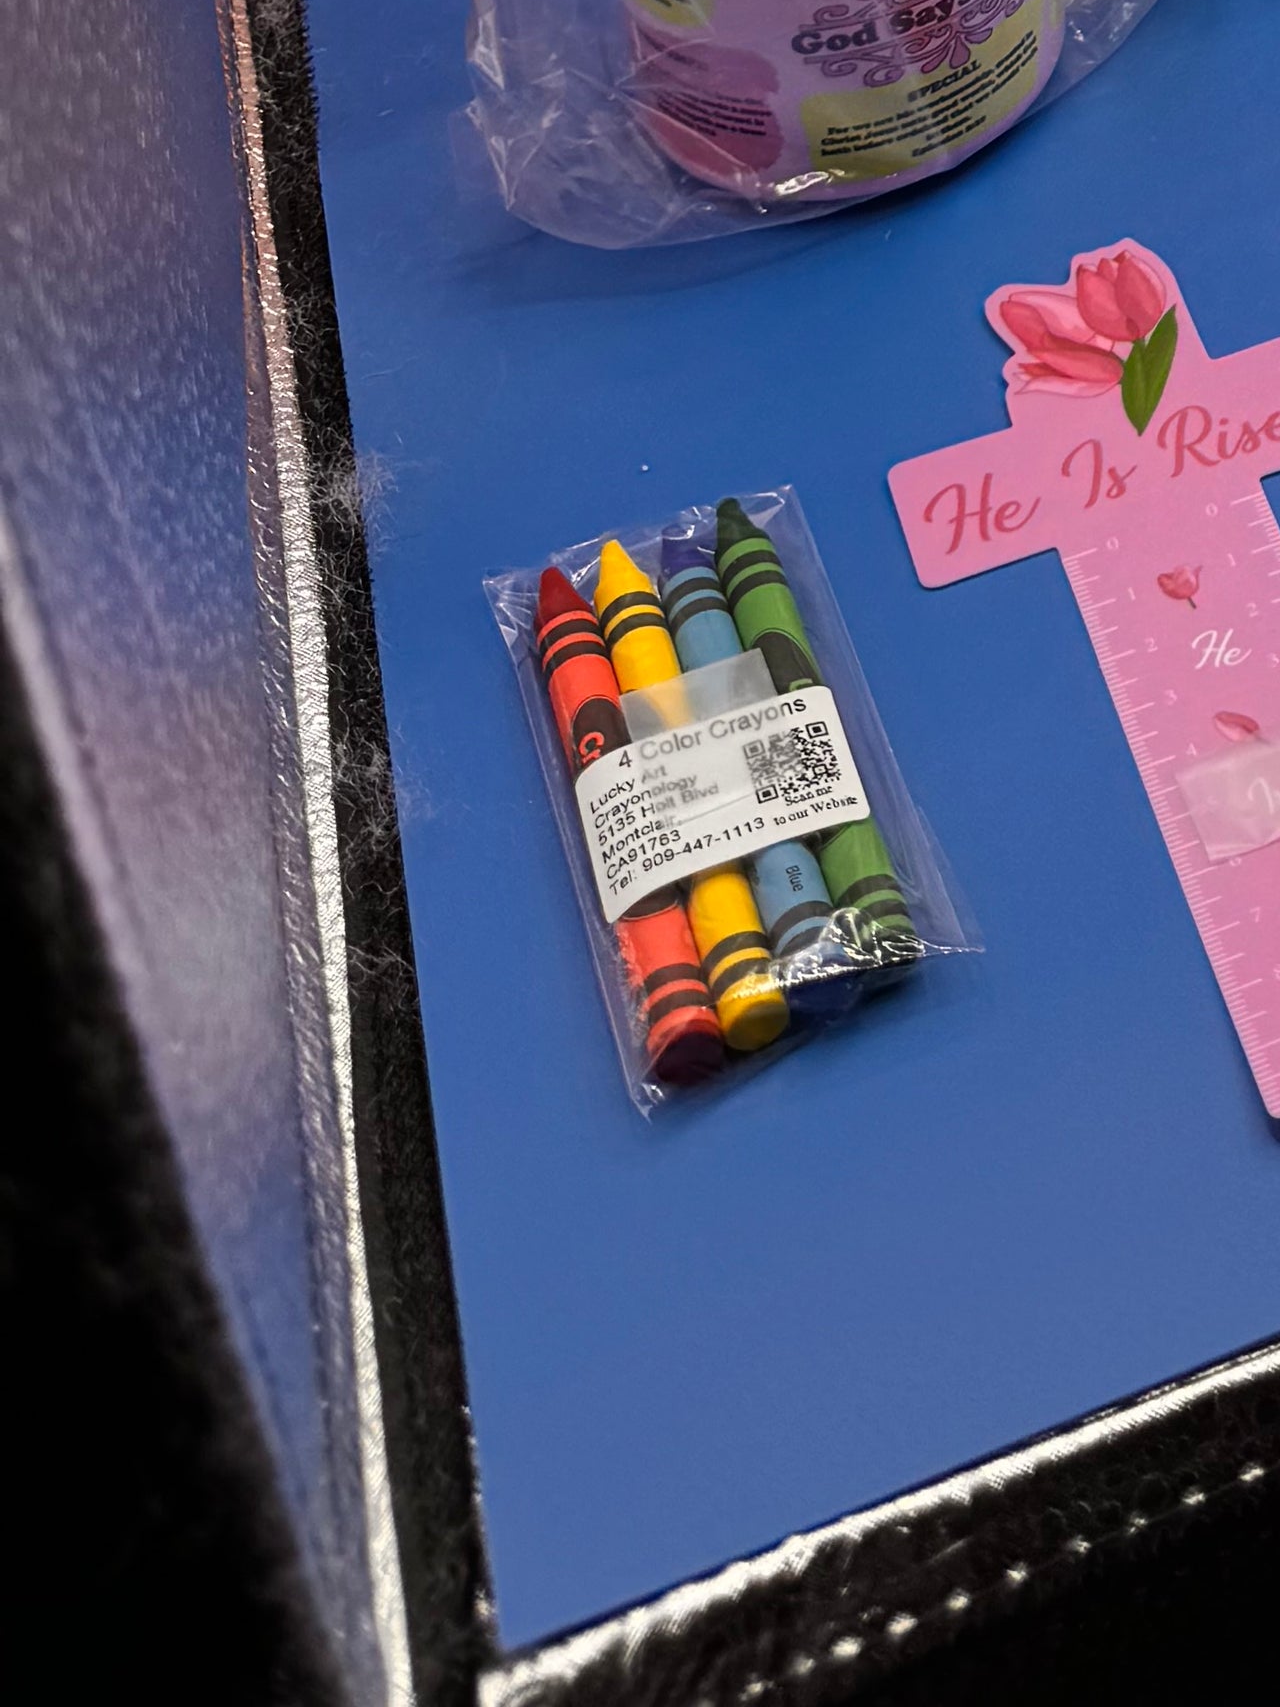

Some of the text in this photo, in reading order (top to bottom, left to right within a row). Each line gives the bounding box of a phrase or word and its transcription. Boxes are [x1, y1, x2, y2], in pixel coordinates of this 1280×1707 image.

[791, 21, 879, 57] God
[923, 473, 1042, 556] He
[1061, 437, 1138, 510] Is
[1191, 628, 1253, 671] He
[618, 750, 633, 769] 4
[639, 730, 702, 762] Color
[709, 697, 807, 740] Crayons
[590, 764, 668, 815] Lucky Art
[594, 775, 697, 829] Crayonology
[598, 784, 719, 846] 5135 Holt Blvd
[773, 794, 858, 827] to our Website
[785, 785, 834, 807] Scan me
[606, 829, 682, 880] CA91763
[608, 816, 766, 896] Tel: 909-447-1113
[785, 864, 804, 892] Blue
